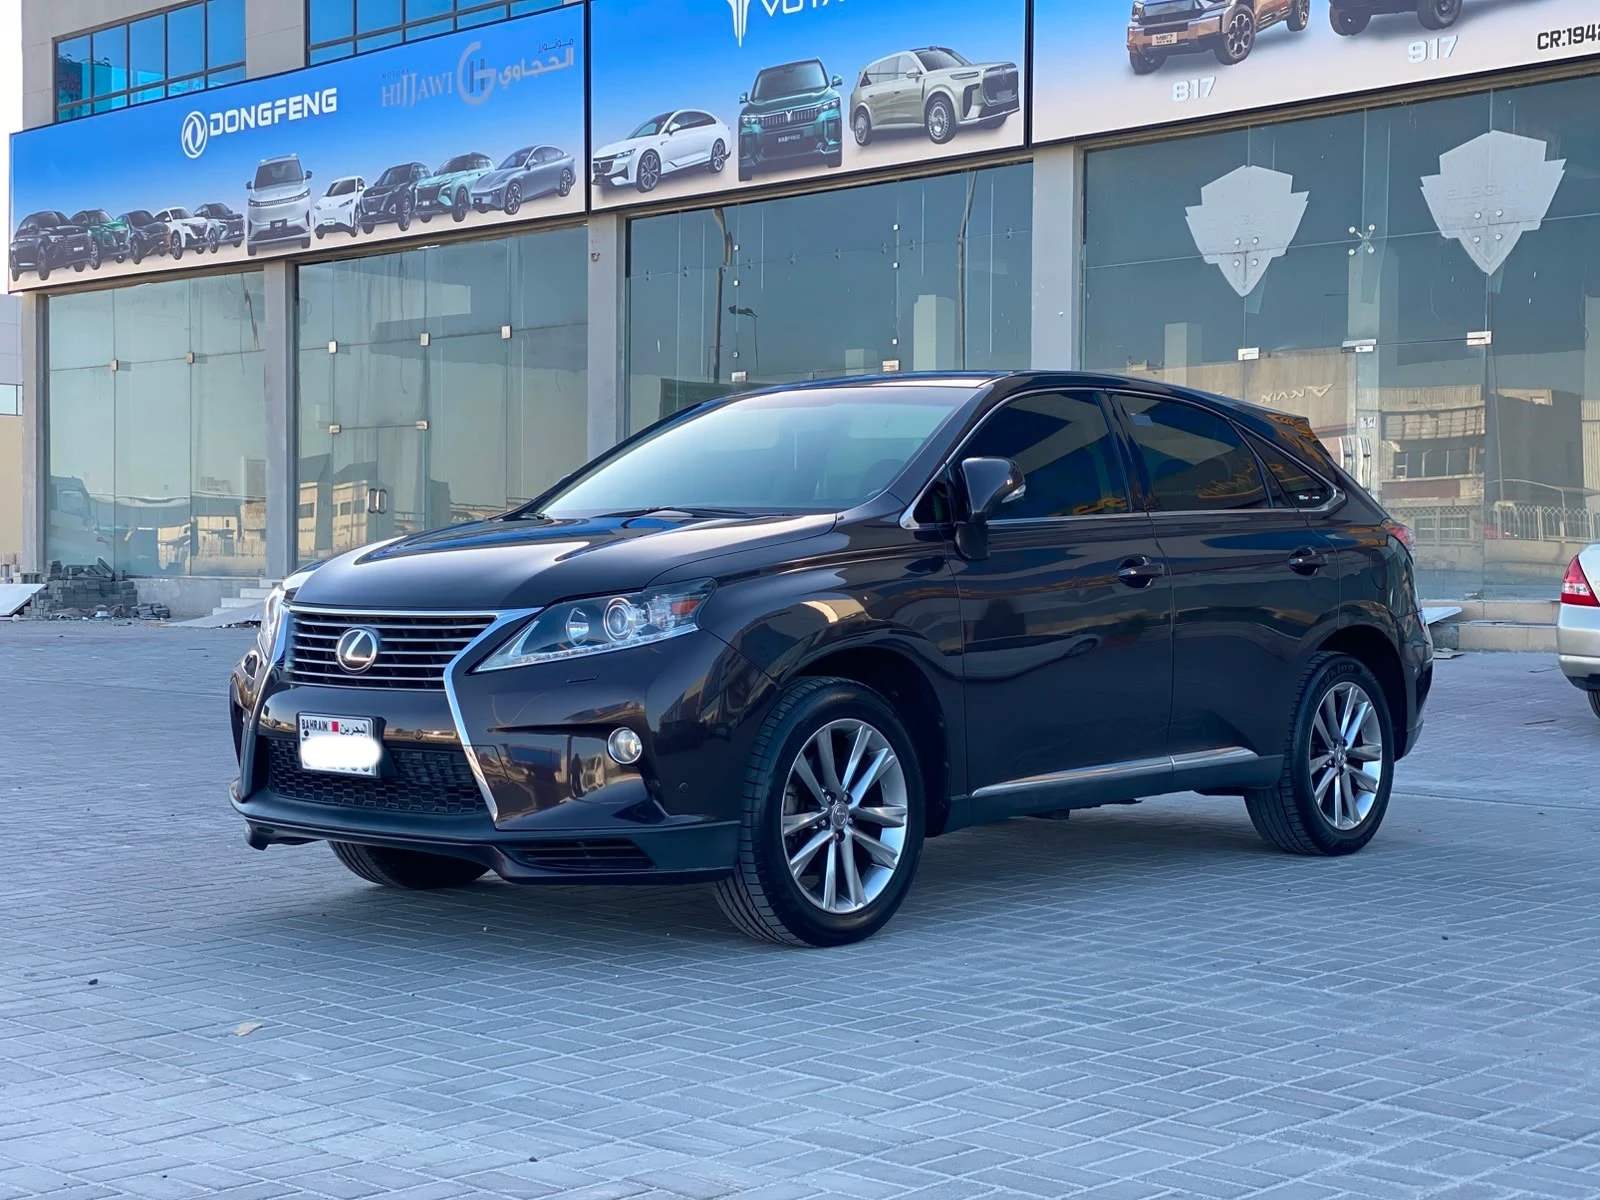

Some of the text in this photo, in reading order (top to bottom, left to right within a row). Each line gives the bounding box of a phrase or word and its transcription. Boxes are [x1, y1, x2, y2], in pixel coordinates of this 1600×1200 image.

[1408, 35, 1459, 64] 917
[1537, 23, 1600, 50] CR:194
[1172, 75, 1217, 103] 817
[209, 87, 338, 136] DONGFENG
[301, 719, 328, 732] BAHRAIN
[339, 722, 368, 736] البحرين
